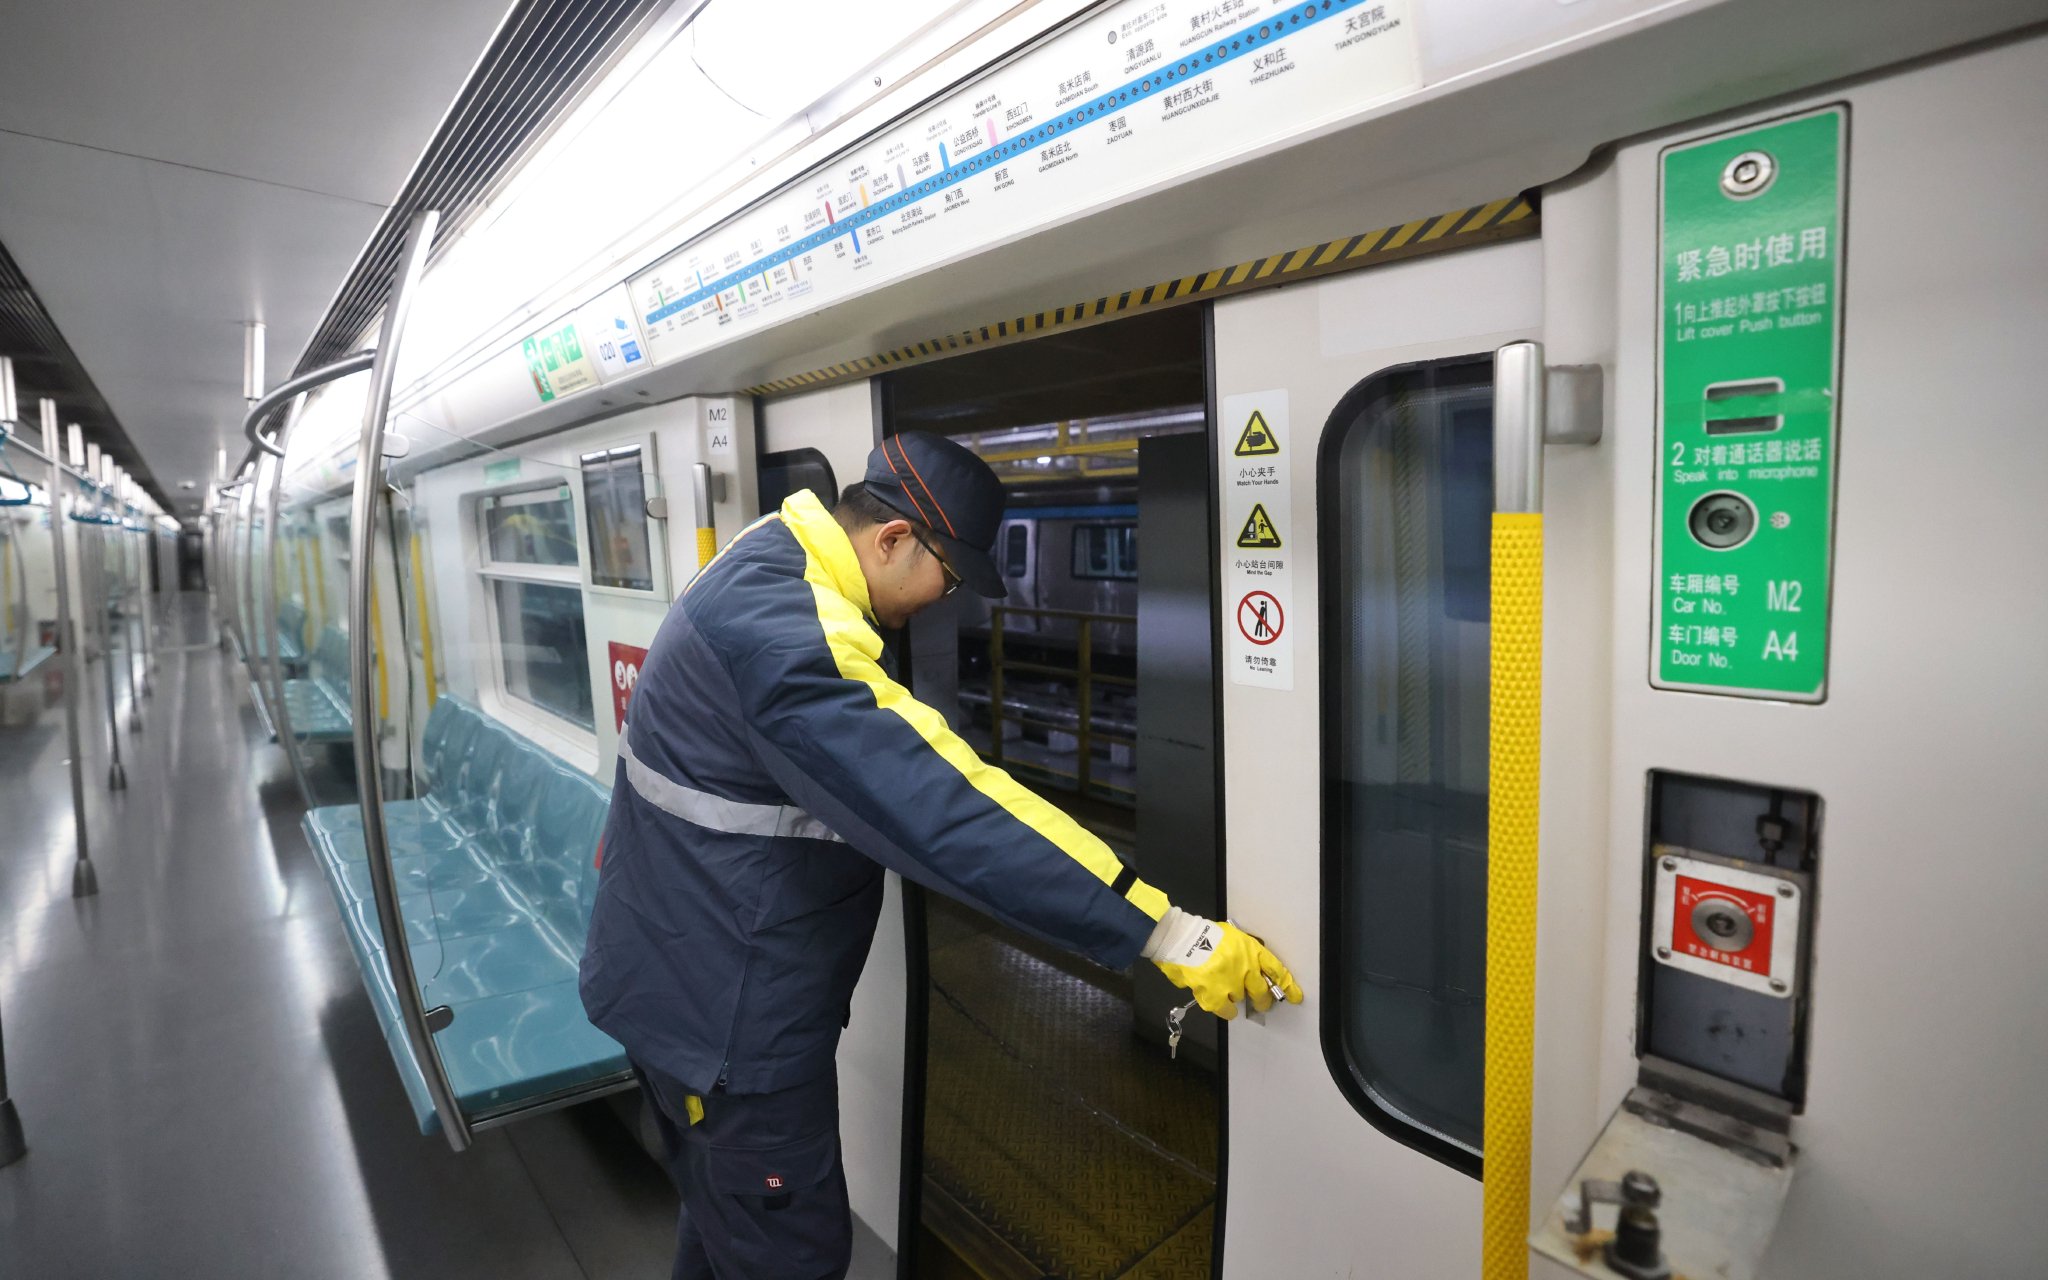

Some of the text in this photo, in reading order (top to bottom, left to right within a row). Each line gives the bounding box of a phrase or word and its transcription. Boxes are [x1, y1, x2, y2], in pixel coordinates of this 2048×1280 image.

[1180, 6, 1261, 47] HUANGCUN Railway Station
[1345, 5, 1386, 34] 天宫院
[1126, 39, 1154, 62] 清源路
[1252, 47, 1288, 73] 义和庄
[1124, 51, 1162, 75] QINGYUANLU
[1249, 62, 1296, 86] YIHEZHUANG
[1058, 70, 1092, 96] 高米店南
[1055, 90, 1084, 108] GAOMIDIAN
[1163, 78, 1214, 111] 黄村西大街
[1005, 102, 1029, 121] 西红门
[1161, 92, 1220, 122] HUANGCUNXIDAJIE
[1108, 115, 1127, 132] 枣园
[953, 126, 979, 147] 公益西桥
[1107, 129, 1133, 145] ZAOYUAN
[1040, 140, 1072, 162] 高米店北
[994, 168, 1009, 182] 新宫
[1676, 226, 1827, 283] 紧急时使用
[1677, 325, 1696, 342] Lift
[1701, 322, 1734, 339] cover
[1739, 317, 1774, 333] Push
[709, 407, 727, 421] M2
[712, 435, 728, 448] A4
[1671, 438, 1822, 468] 2 对着通话器说话
[1236, 478, 1279, 487] Watch Your Hands
[1239, 466, 1276, 479] 小心夹手
[1673, 465, 1819, 484] Speak into microphone
[1235, 559, 1284, 570] 小心站台间隙
[1669, 574, 1741, 596] 车厢编号
[1767, 579, 1803, 613] M2
[1672, 597, 1727, 615] Car No.
[1668, 623, 1739, 648] 车门编号
[1762, 629, 1799, 662] A4
[1244, 654, 1277, 667] 请勿倚靠
[1671, 650, 1734, 669] Door No.
